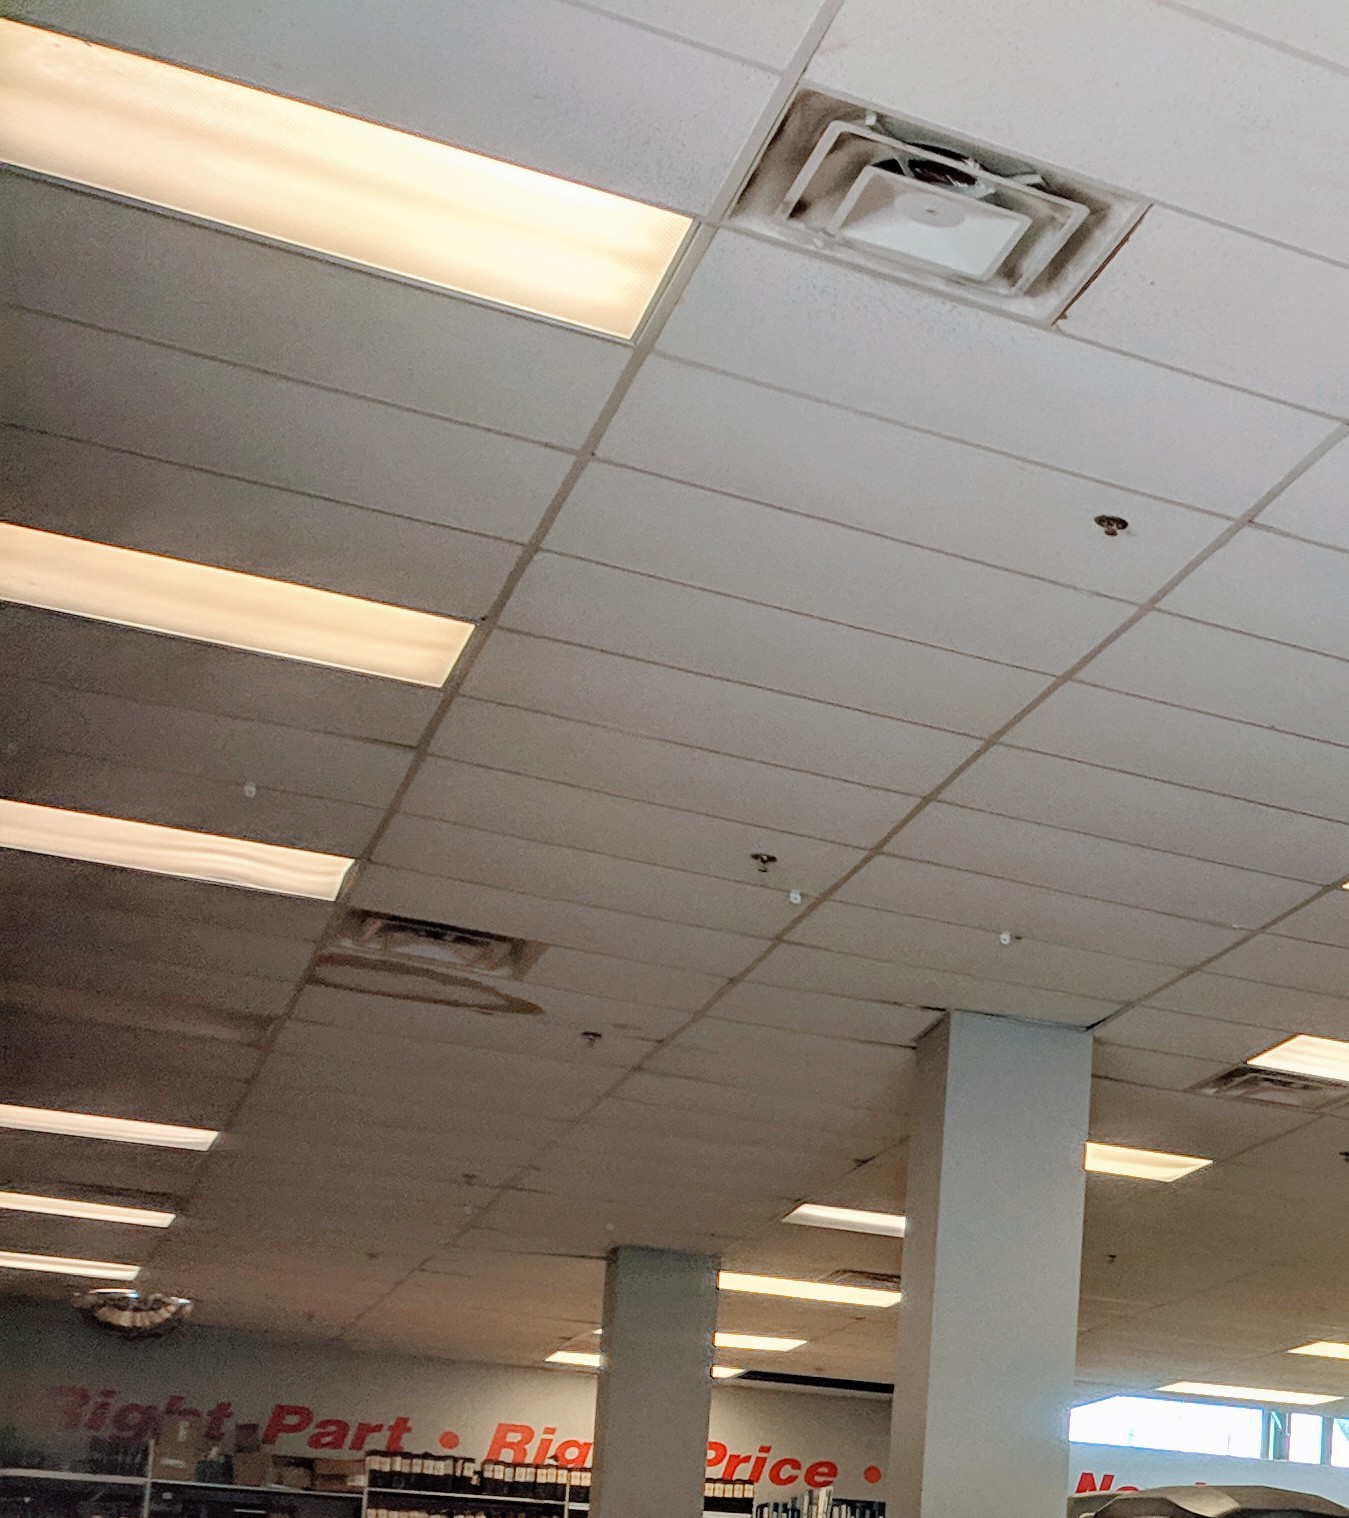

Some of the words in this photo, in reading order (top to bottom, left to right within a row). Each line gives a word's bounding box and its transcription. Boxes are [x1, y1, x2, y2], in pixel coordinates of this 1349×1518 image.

[262, 1403, 412, 1451] Part
[485, 1422, 594, 1469] Rig
[705, 1440, 839, 1488] Price
